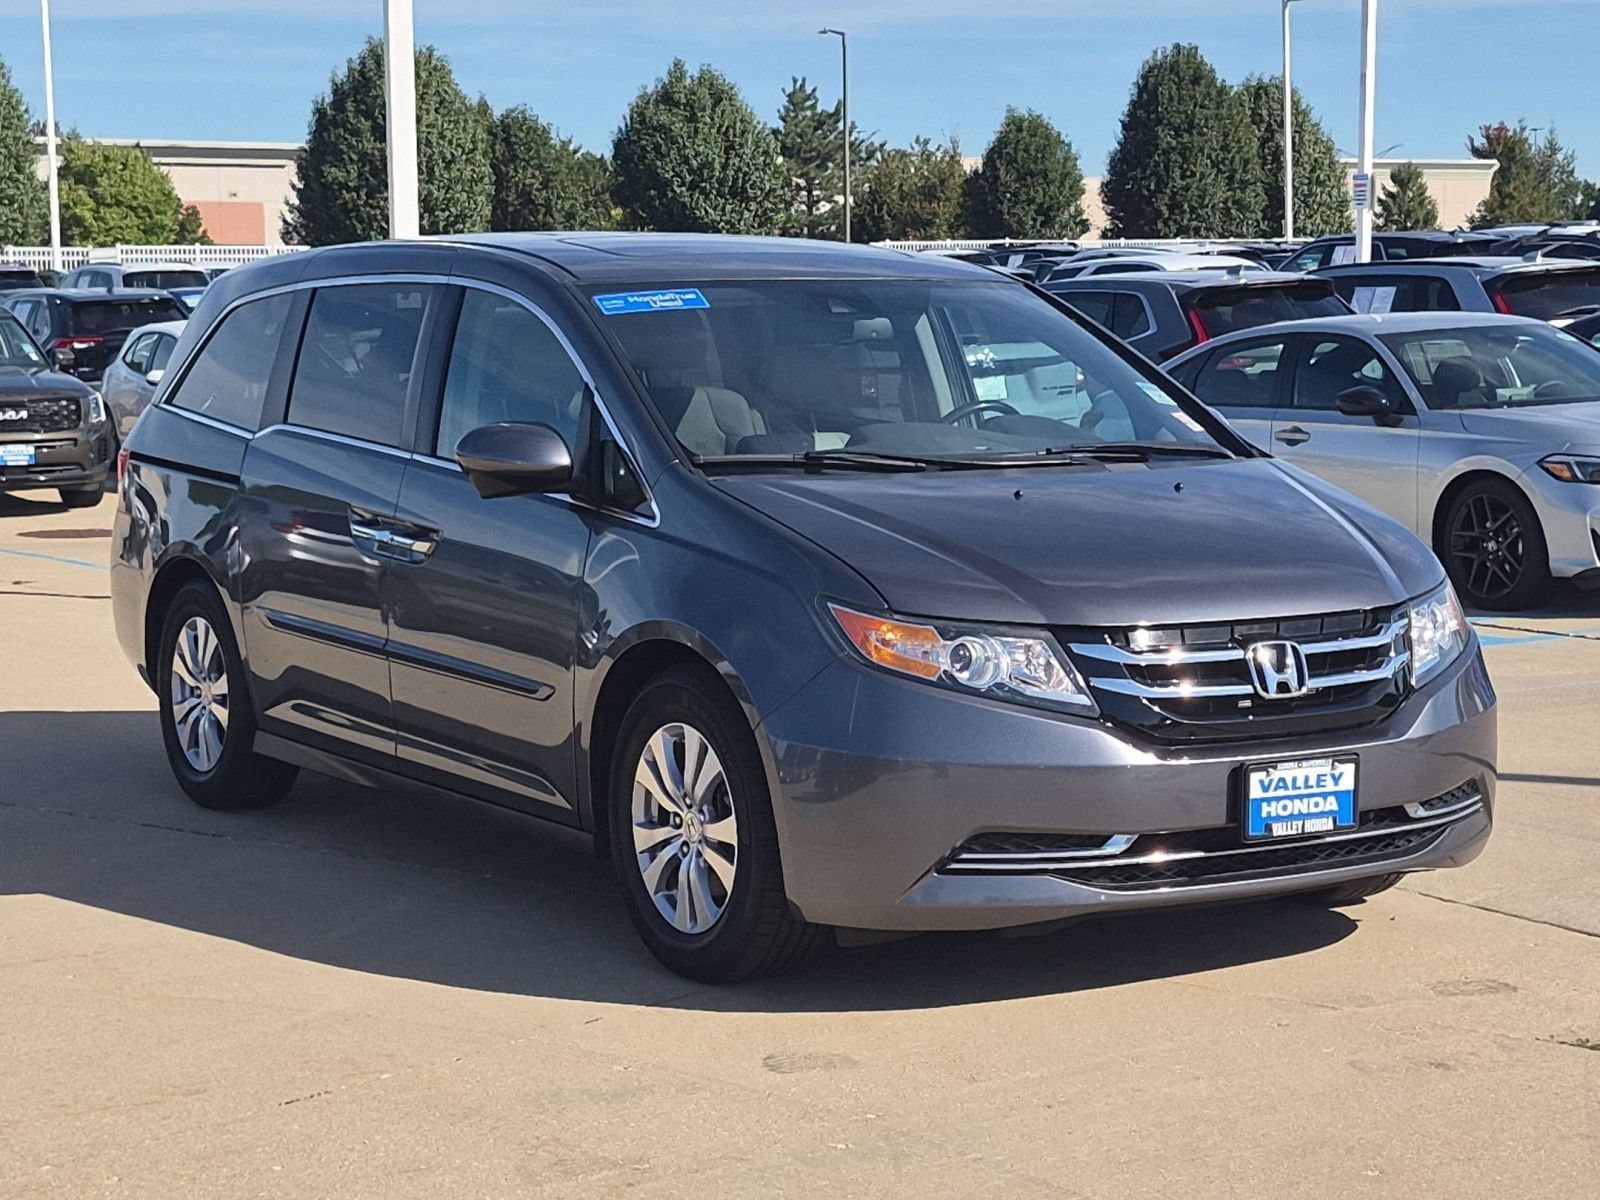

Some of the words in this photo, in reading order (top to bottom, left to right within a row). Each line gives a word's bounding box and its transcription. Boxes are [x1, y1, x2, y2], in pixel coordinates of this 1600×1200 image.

[1258, 771, 1344, 793] VALLEY
[1261, 795, 1339, 818] HONDA
[1272, 820, 1303, 837] VALLEY
[1304, 816, 1334, 833] HONDA
